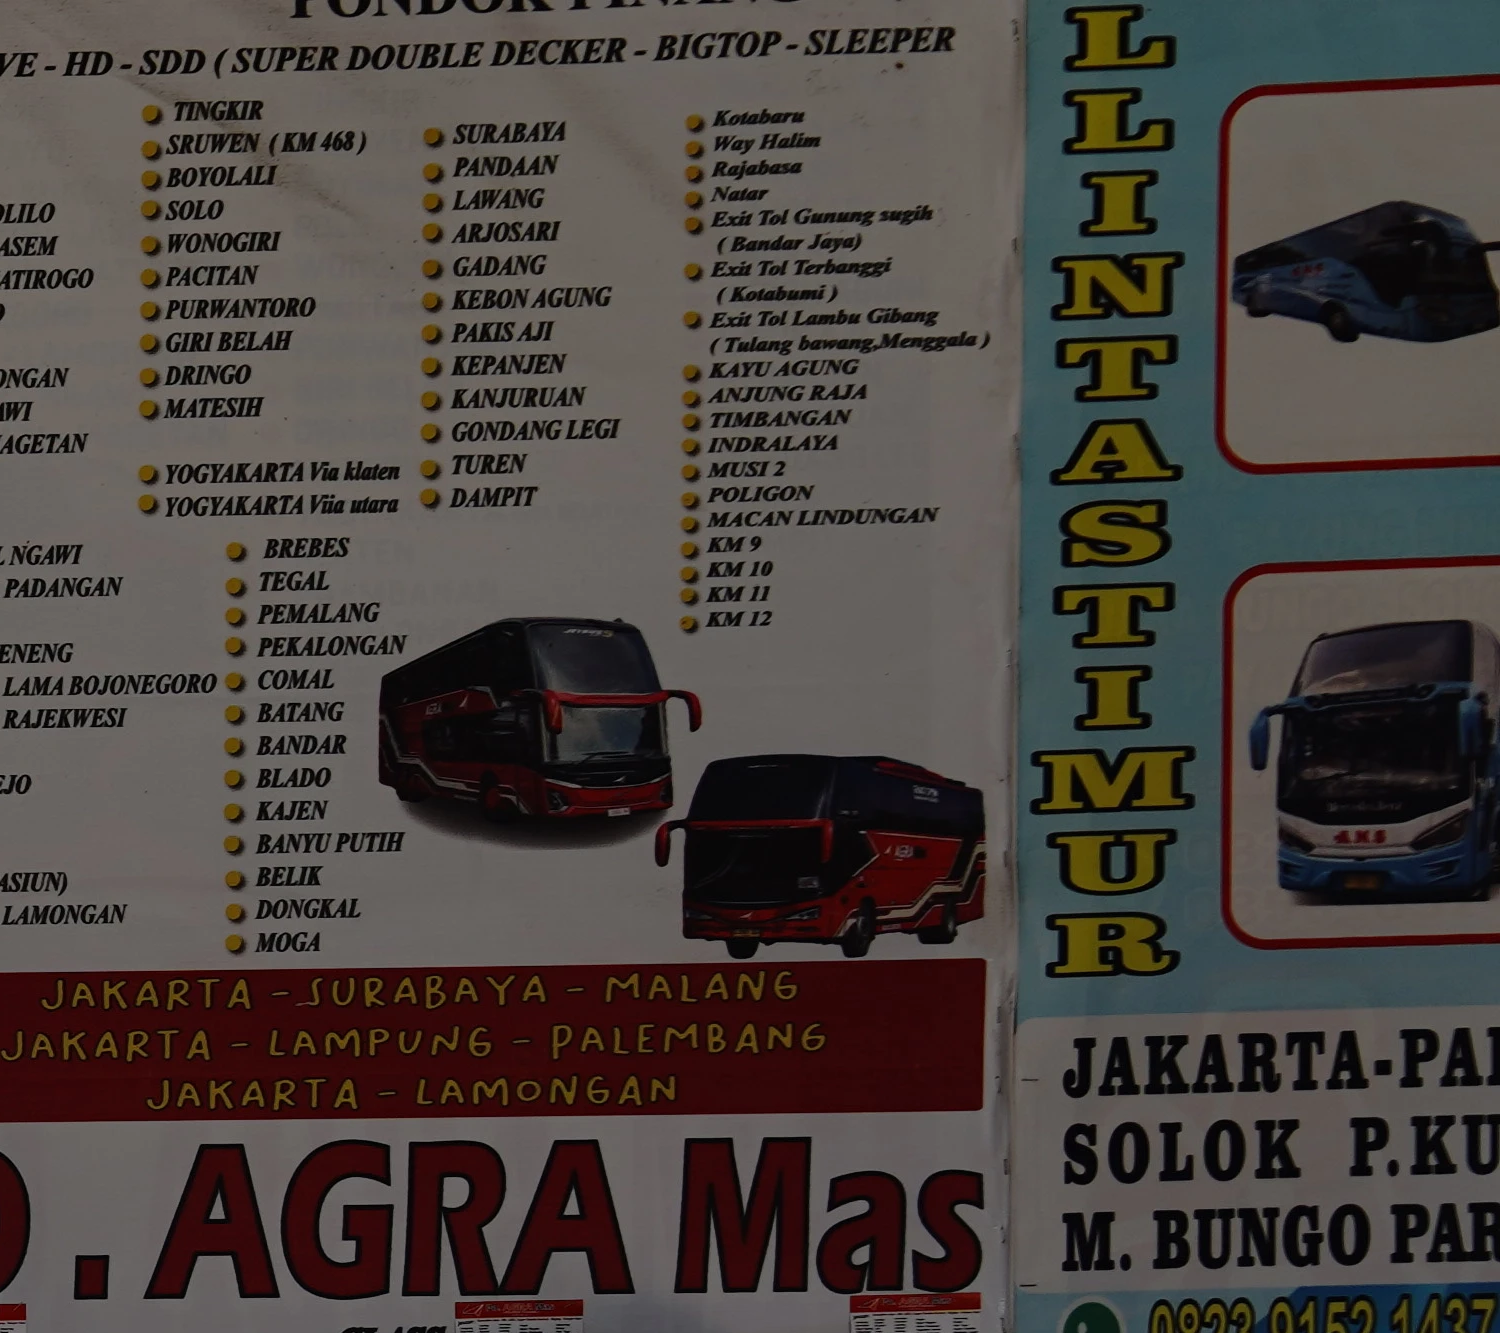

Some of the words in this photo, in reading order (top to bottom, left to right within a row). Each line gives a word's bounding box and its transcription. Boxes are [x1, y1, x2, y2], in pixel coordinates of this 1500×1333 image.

[62, 51, 113, 76] HD
[138, 49, 206, 75] SDD
[231, 46, 339, 73] SUPER
[347, 42, 483, 70] DOUBLE
[490, 38, 627, 66] DECKER
[653, 31, 782, 61] BIGTOP
[804, 27, 955, 55] SLEEPER
[453, 121, 565, 144] SURABAYA
[166, 165, 278, 187] BOYOLALI
[711, 160, 803, 180] Rajabasa
[707, 461, 770, 478] MUSI
[774, 461, 784, 478] 2
[3, 577, 123, 598] PADANGAN
[708, 608, 742, 629] KM
[747, 607, 771, 628] 12
[257, 635, 408, 657] PEKALONGAN
[40, 977, 252, 1012] JAKARTA
[296, 973, 548, 1010] SURABAYA
[604, 968, 799, 1004] MALANG
[1063, 1027, 1500, 1098] JAKARTA-PA
[1064, 1119, 1301, 1185] SOLOK
[145, 1137, 635, 1302] AGRA
[674, 1137, 985, 1297] Mas
[1062, 1212, 1131, 1271] M.
[1153, 1204, 1371, 1269] BUNGO
